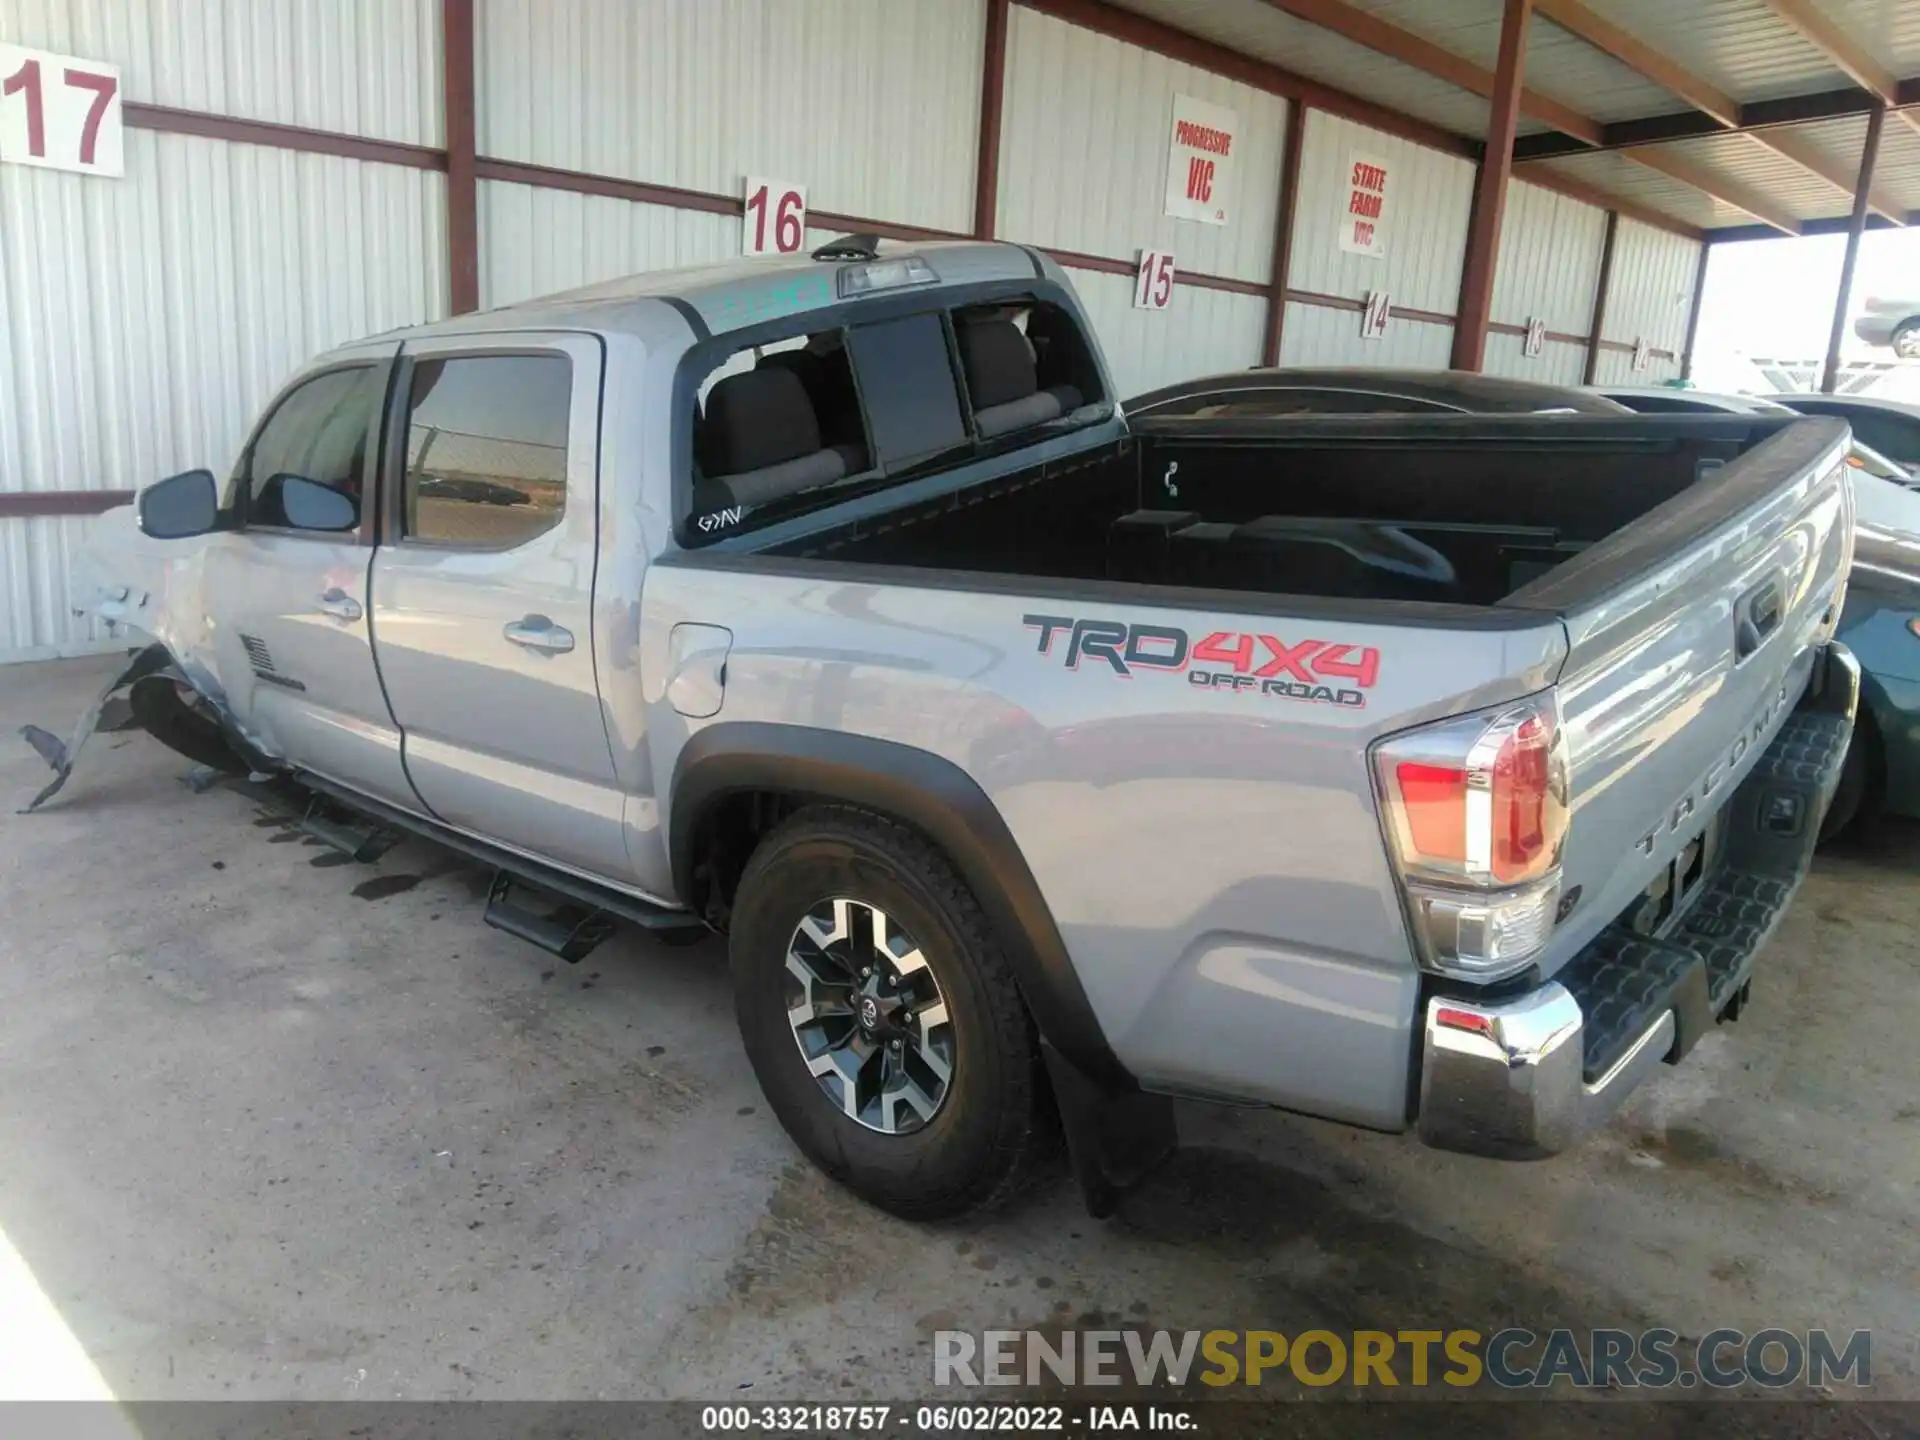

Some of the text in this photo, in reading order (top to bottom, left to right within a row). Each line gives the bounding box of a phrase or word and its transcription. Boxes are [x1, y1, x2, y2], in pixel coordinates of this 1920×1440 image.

[4, 59, 117, 164] 17
[1175, 119, 1232, 156] PROGRESSIVE
[1187, 156, 1215, 203] VIC
[1352, 162, 1387, 192] STATE
[747, 185, 802, 253] 16
[1349, 191, 1383, 219] FARM
[1354, 220, 1375, 245] VIC
[1142, 253, 1173, 308] 15
[1367, 292, 1390, 336] 14
[1635, 688, 1787, 857] TACOMA
